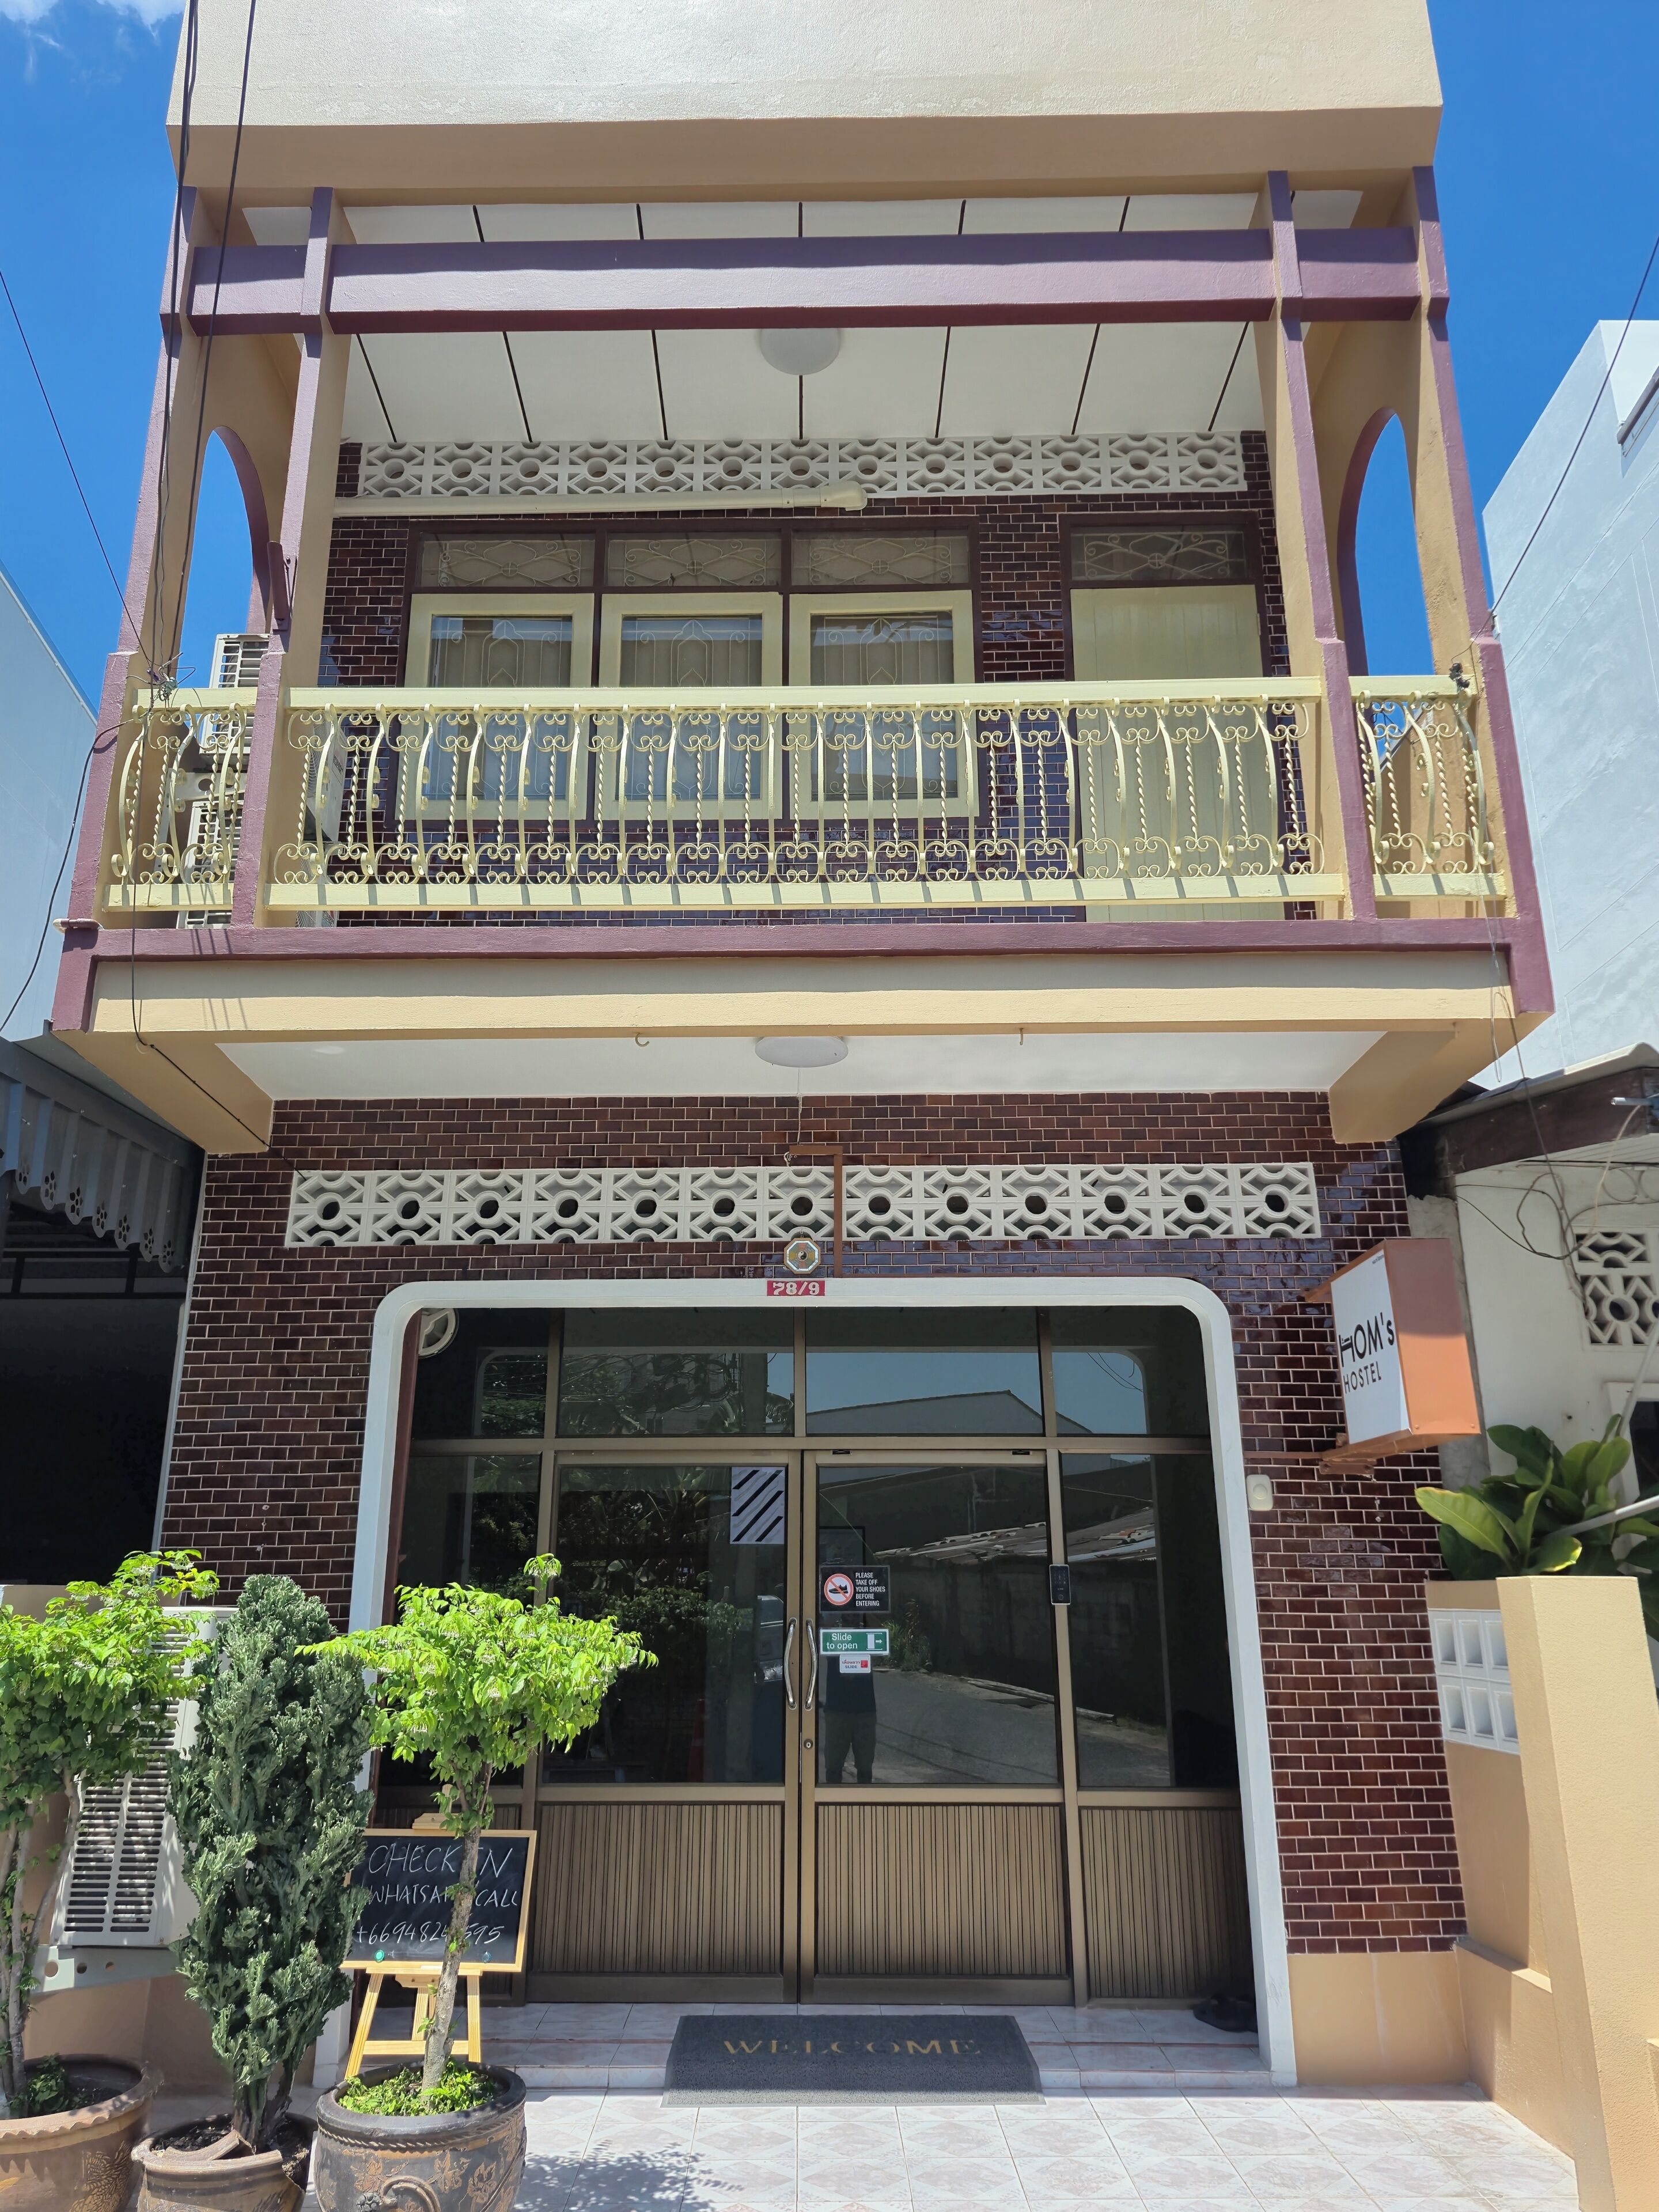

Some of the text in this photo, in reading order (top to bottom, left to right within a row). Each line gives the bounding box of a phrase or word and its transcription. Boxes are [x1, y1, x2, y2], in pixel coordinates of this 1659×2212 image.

[772, 1282, 820, 1295] 78/9
[1339, 1312, 1395, 1368] HOM's
[1343, 1361, 1382, 1393] HOSTEL
[831, 1633, 852, 1641] Slide
[369, 1843, 513, 1878] CHECK N
[724, 2040, 980, 2054] WELCOME
